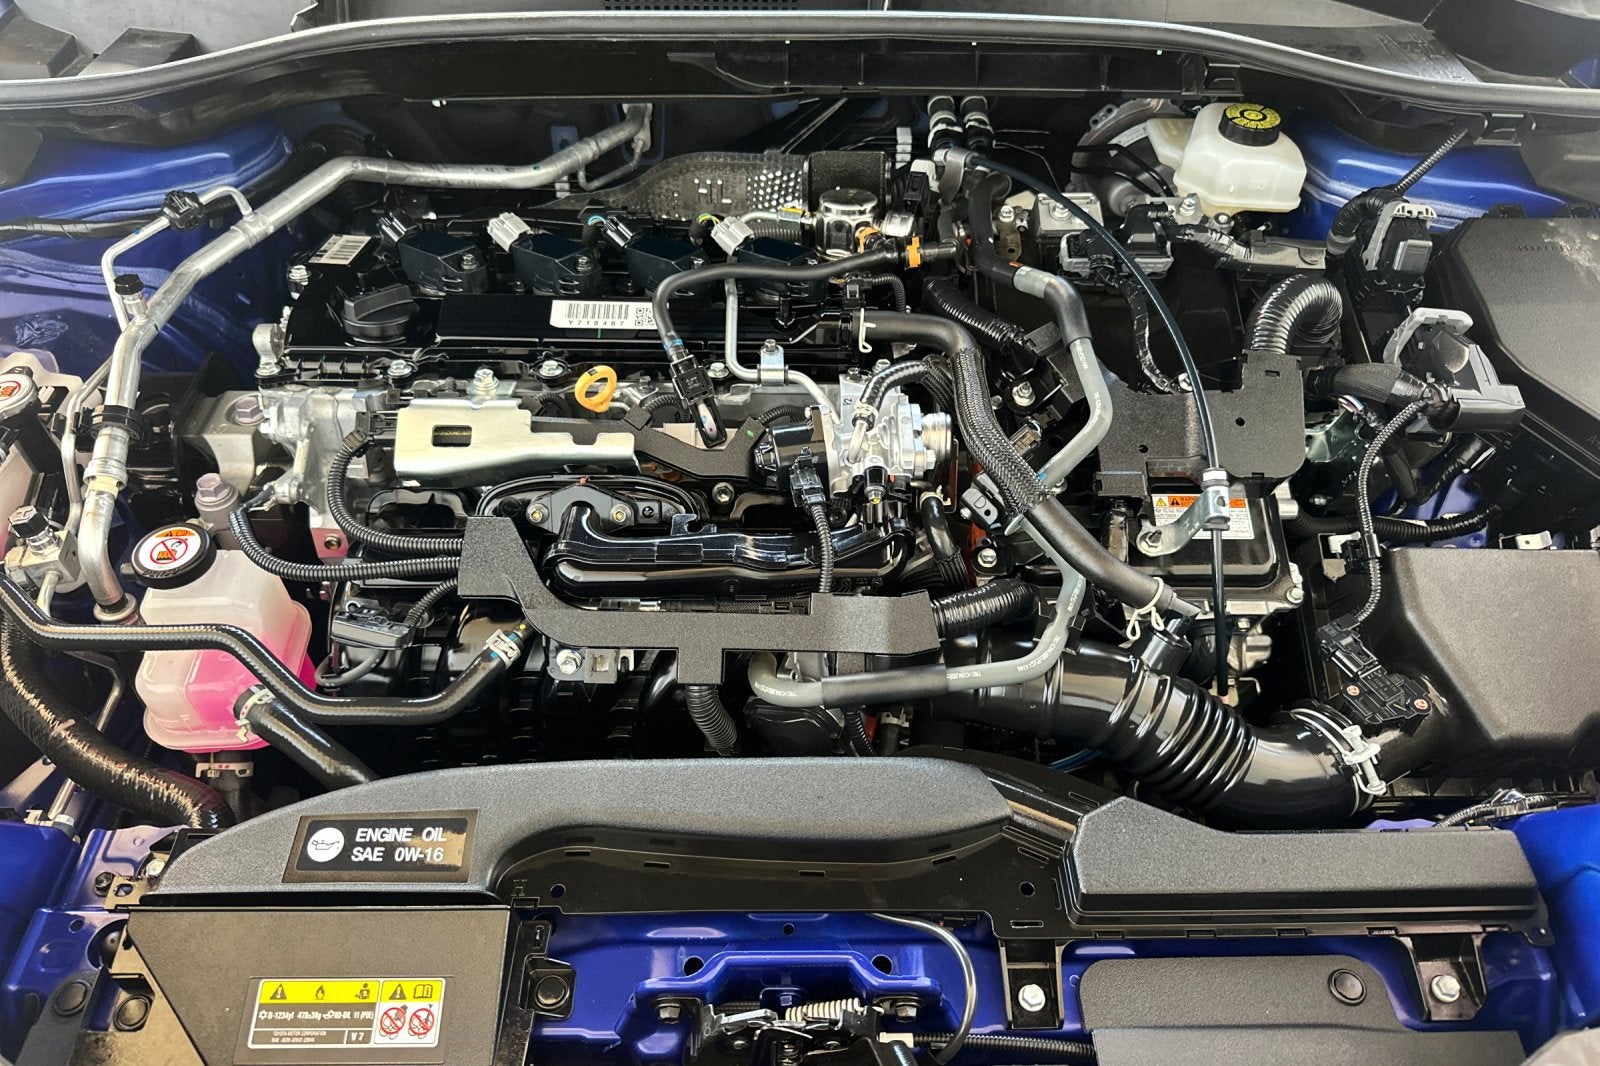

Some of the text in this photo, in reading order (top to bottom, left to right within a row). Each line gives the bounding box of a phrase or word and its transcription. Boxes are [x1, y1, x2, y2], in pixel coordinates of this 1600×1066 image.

[355, 827, 448, 842] ENGINE OIL
[351, 847, 444, 862] SAE 0W-16
